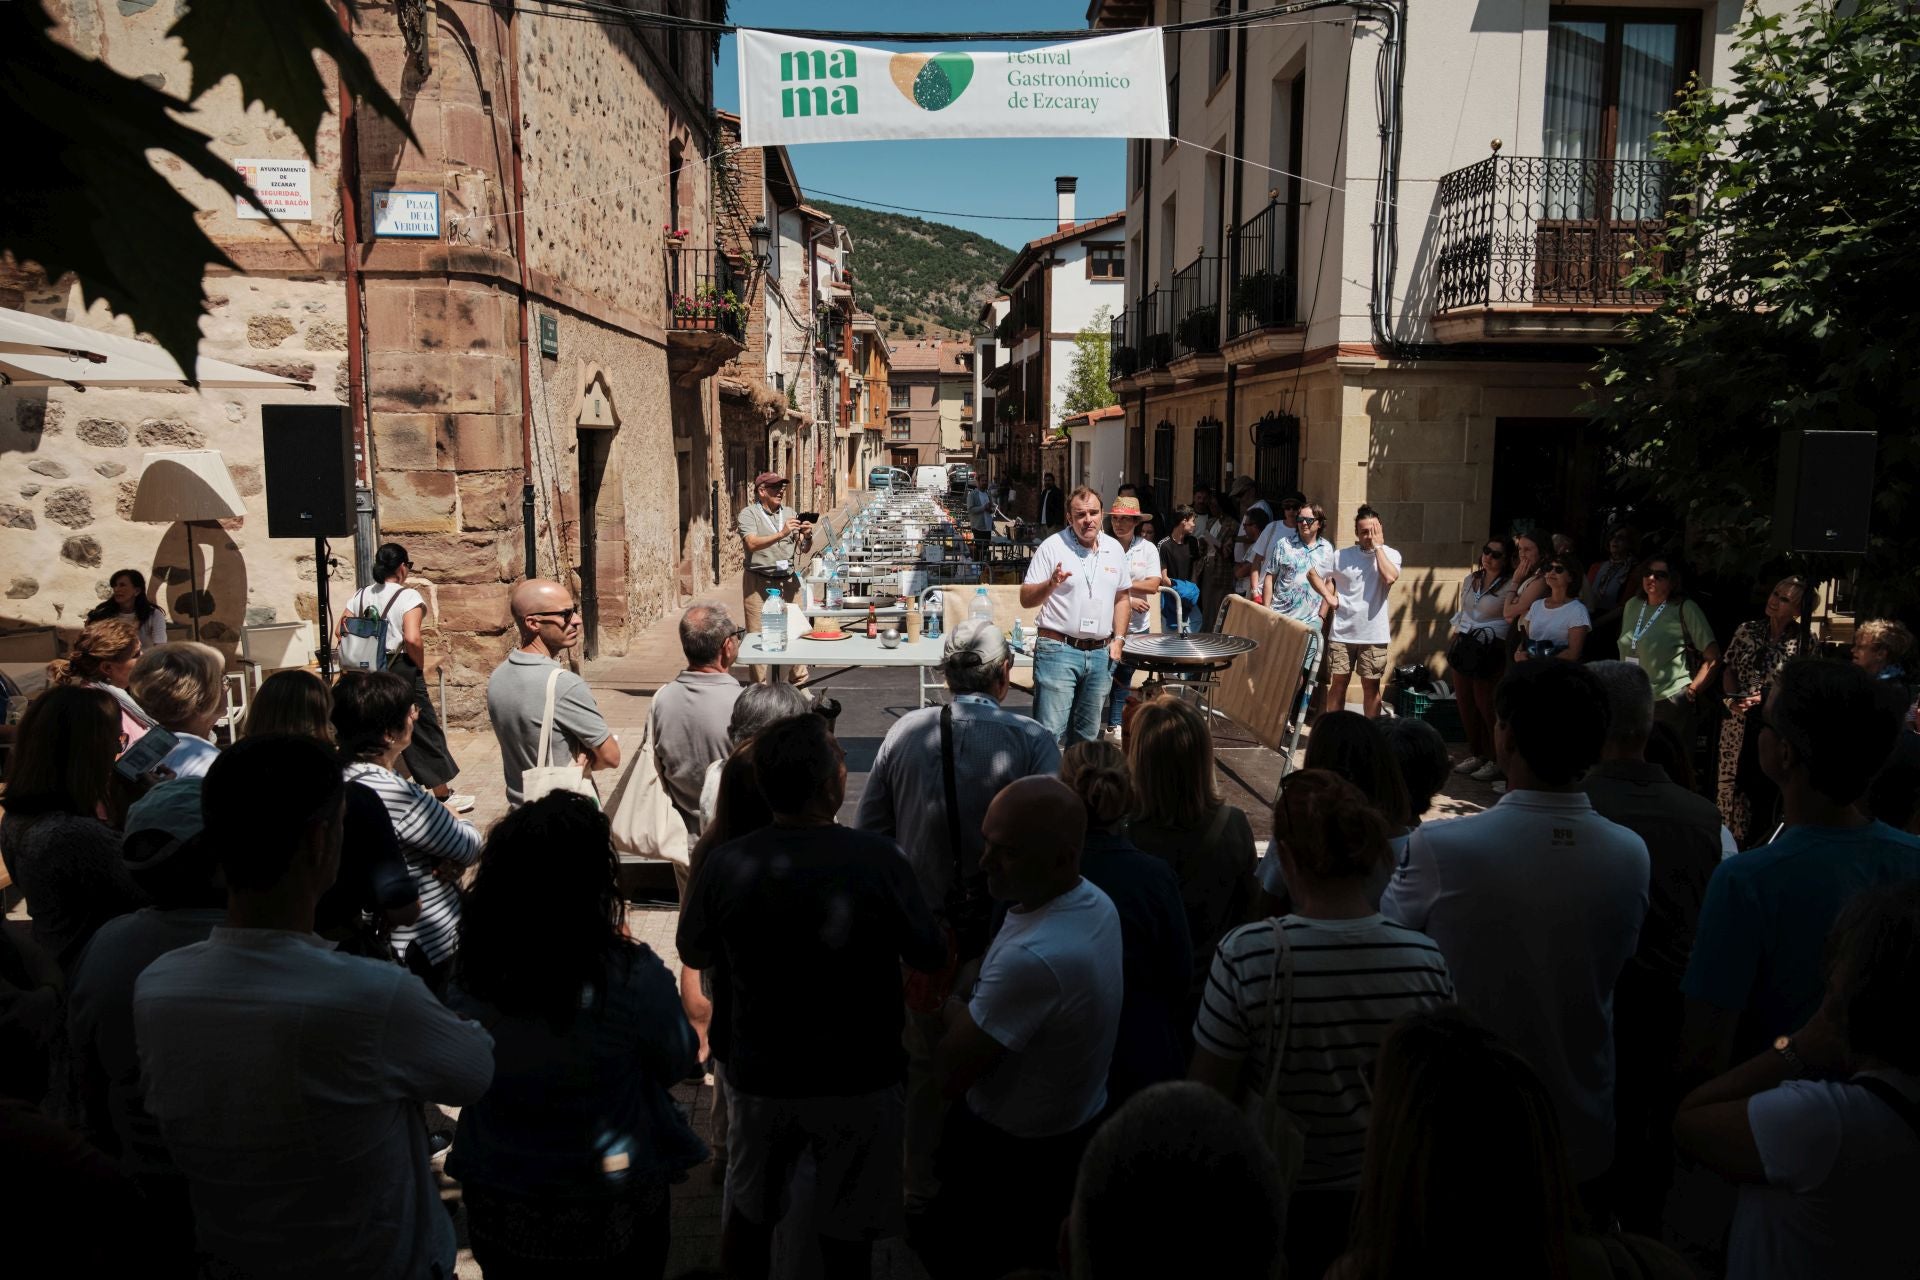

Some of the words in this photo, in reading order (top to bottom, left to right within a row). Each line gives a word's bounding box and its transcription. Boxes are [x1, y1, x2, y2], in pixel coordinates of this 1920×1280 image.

[781, 49, 857, 81] ma
[1007, 49, 1071, 65] Festival
[1007, 69, 1130, 89] Gastronómico
[782, 85, 859, 118] ma
[1008, 91, 1029, 109] de
[1033, 92, 1099, 114] Ezcaray
[406, 199, 434, 209] PLAZA
[410, 211, 422, 221] DE
[424, 211, 434, 221] LA
[394, 221, 434, 232] VERDURA
